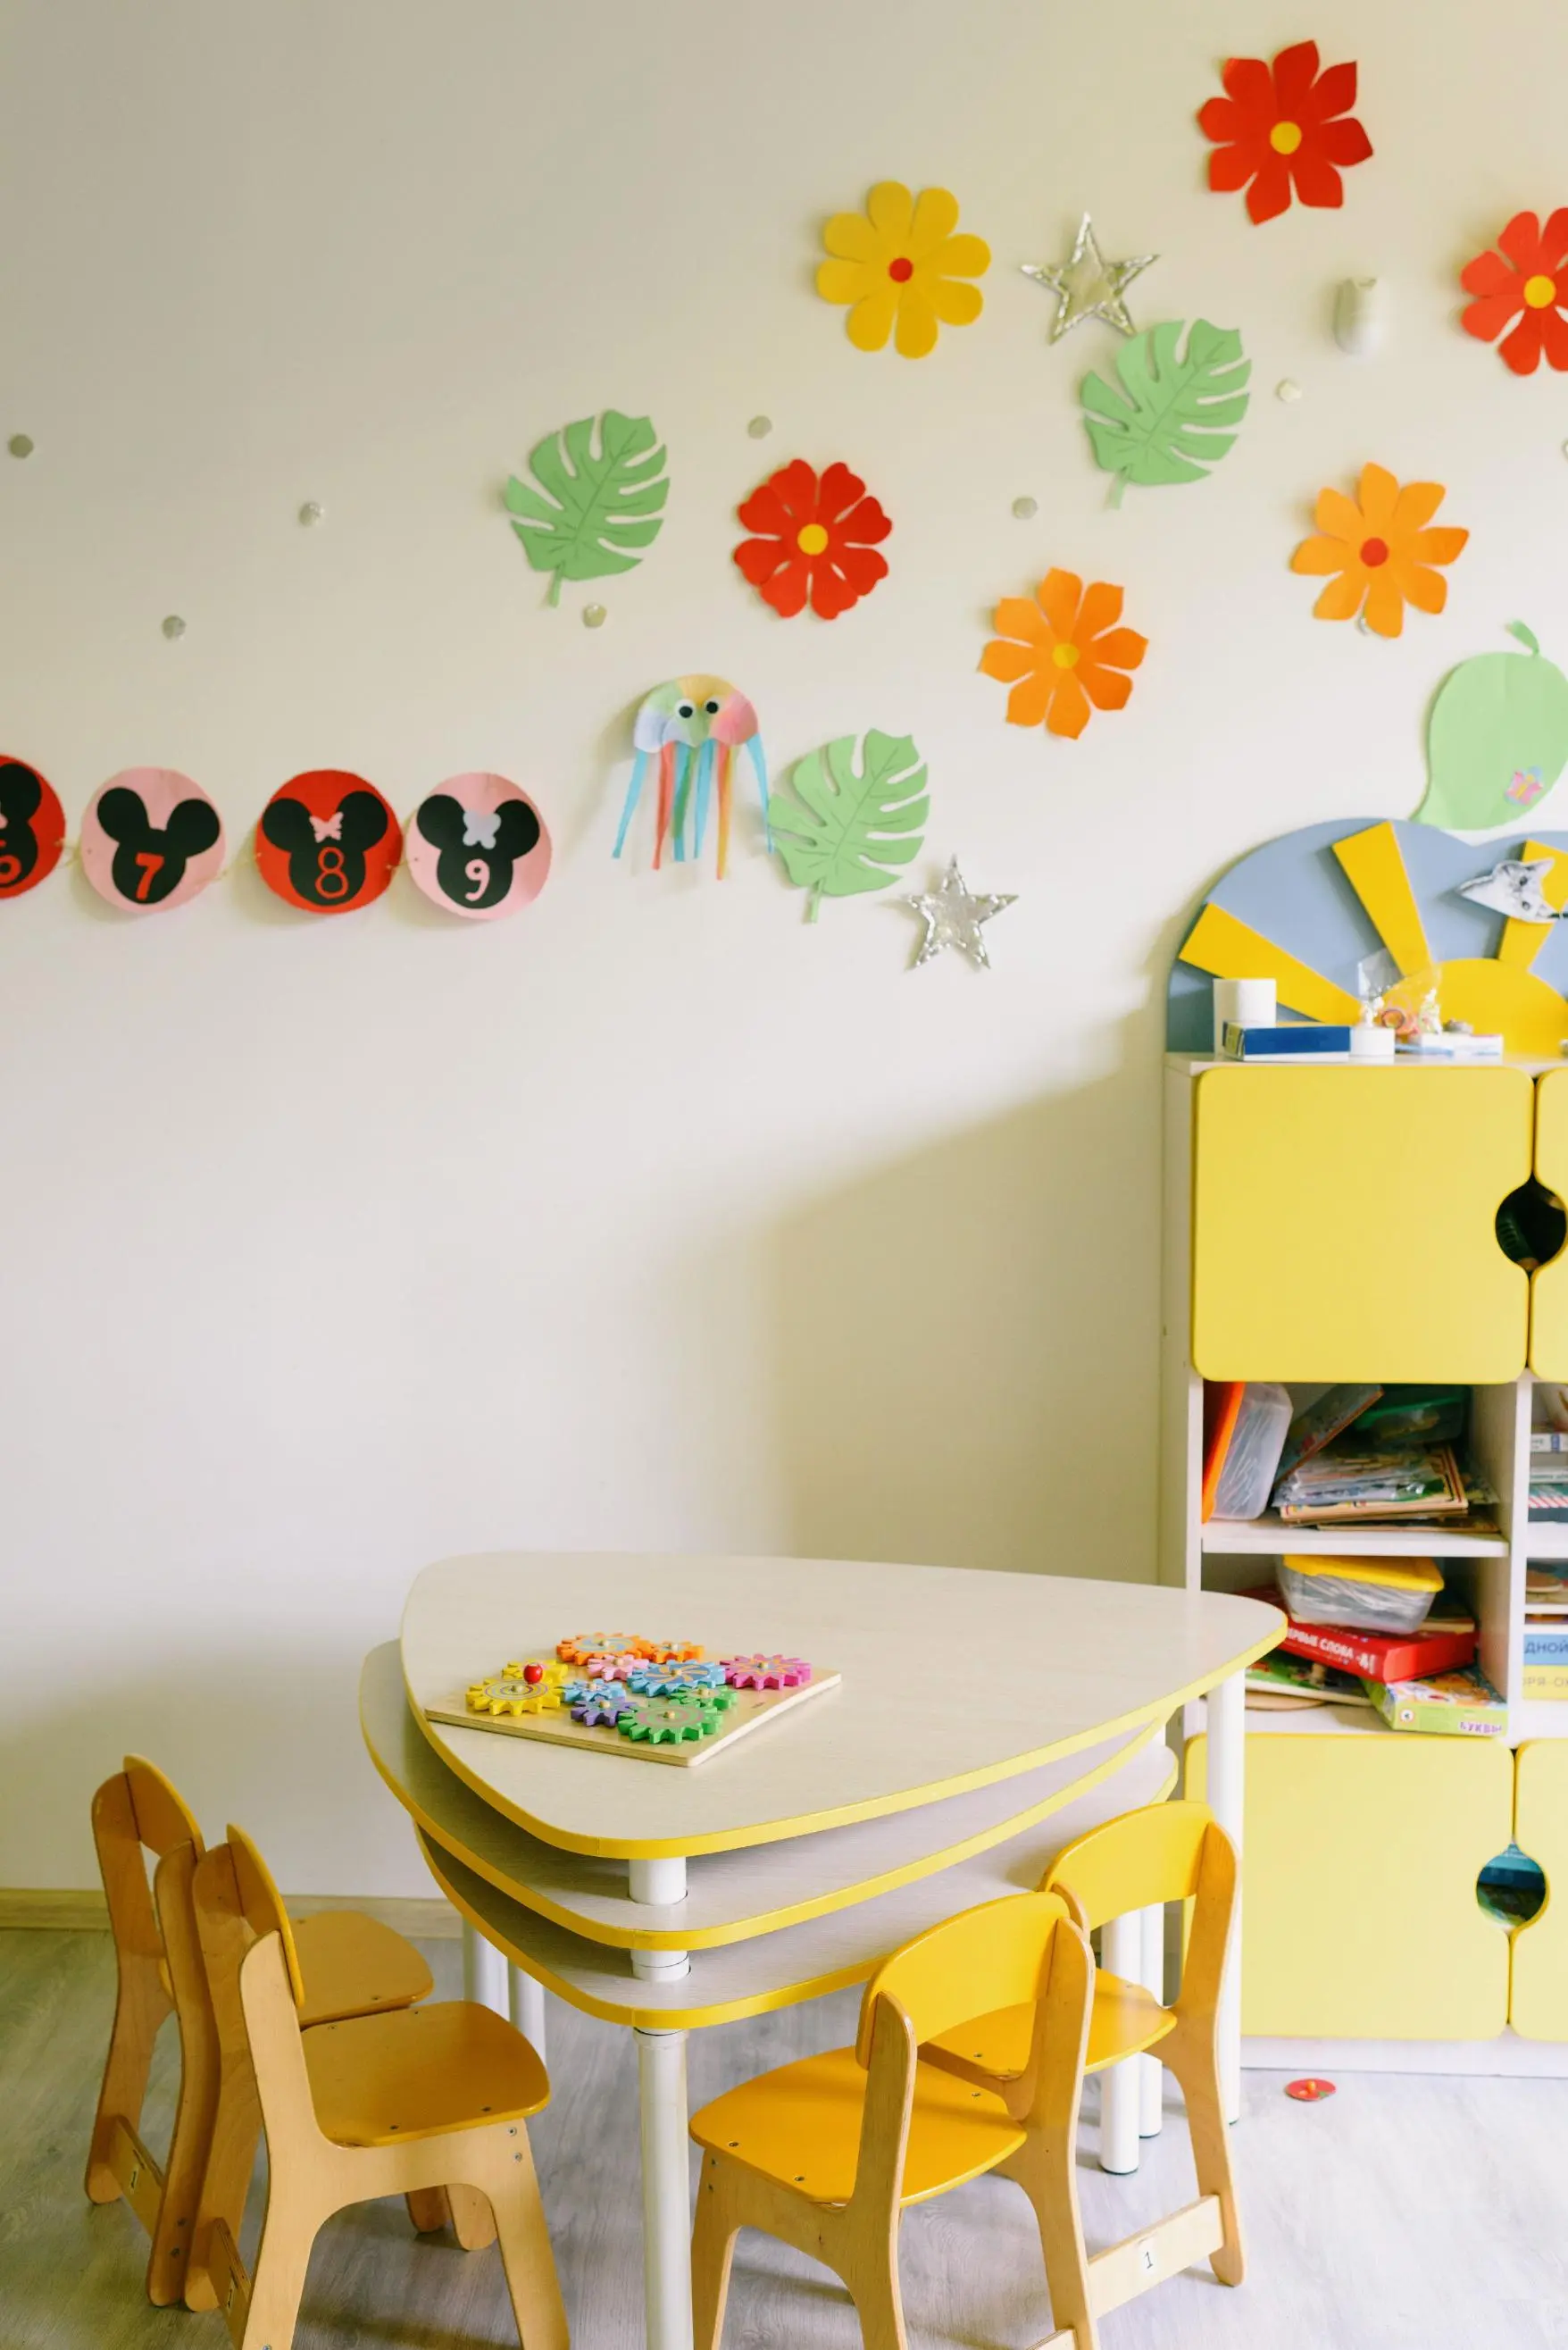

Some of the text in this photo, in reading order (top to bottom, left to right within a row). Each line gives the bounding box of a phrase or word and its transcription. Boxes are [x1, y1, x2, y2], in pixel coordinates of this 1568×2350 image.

[135, 851, 164, 900] 7
[315, 847, 349, 899] 8
[464, 858, 490, 901] 9
[1287, 1627, 1354, 1660] ЕРВЫЕ СЛОВА
[1144, 2251, 1154, 2270] 1
